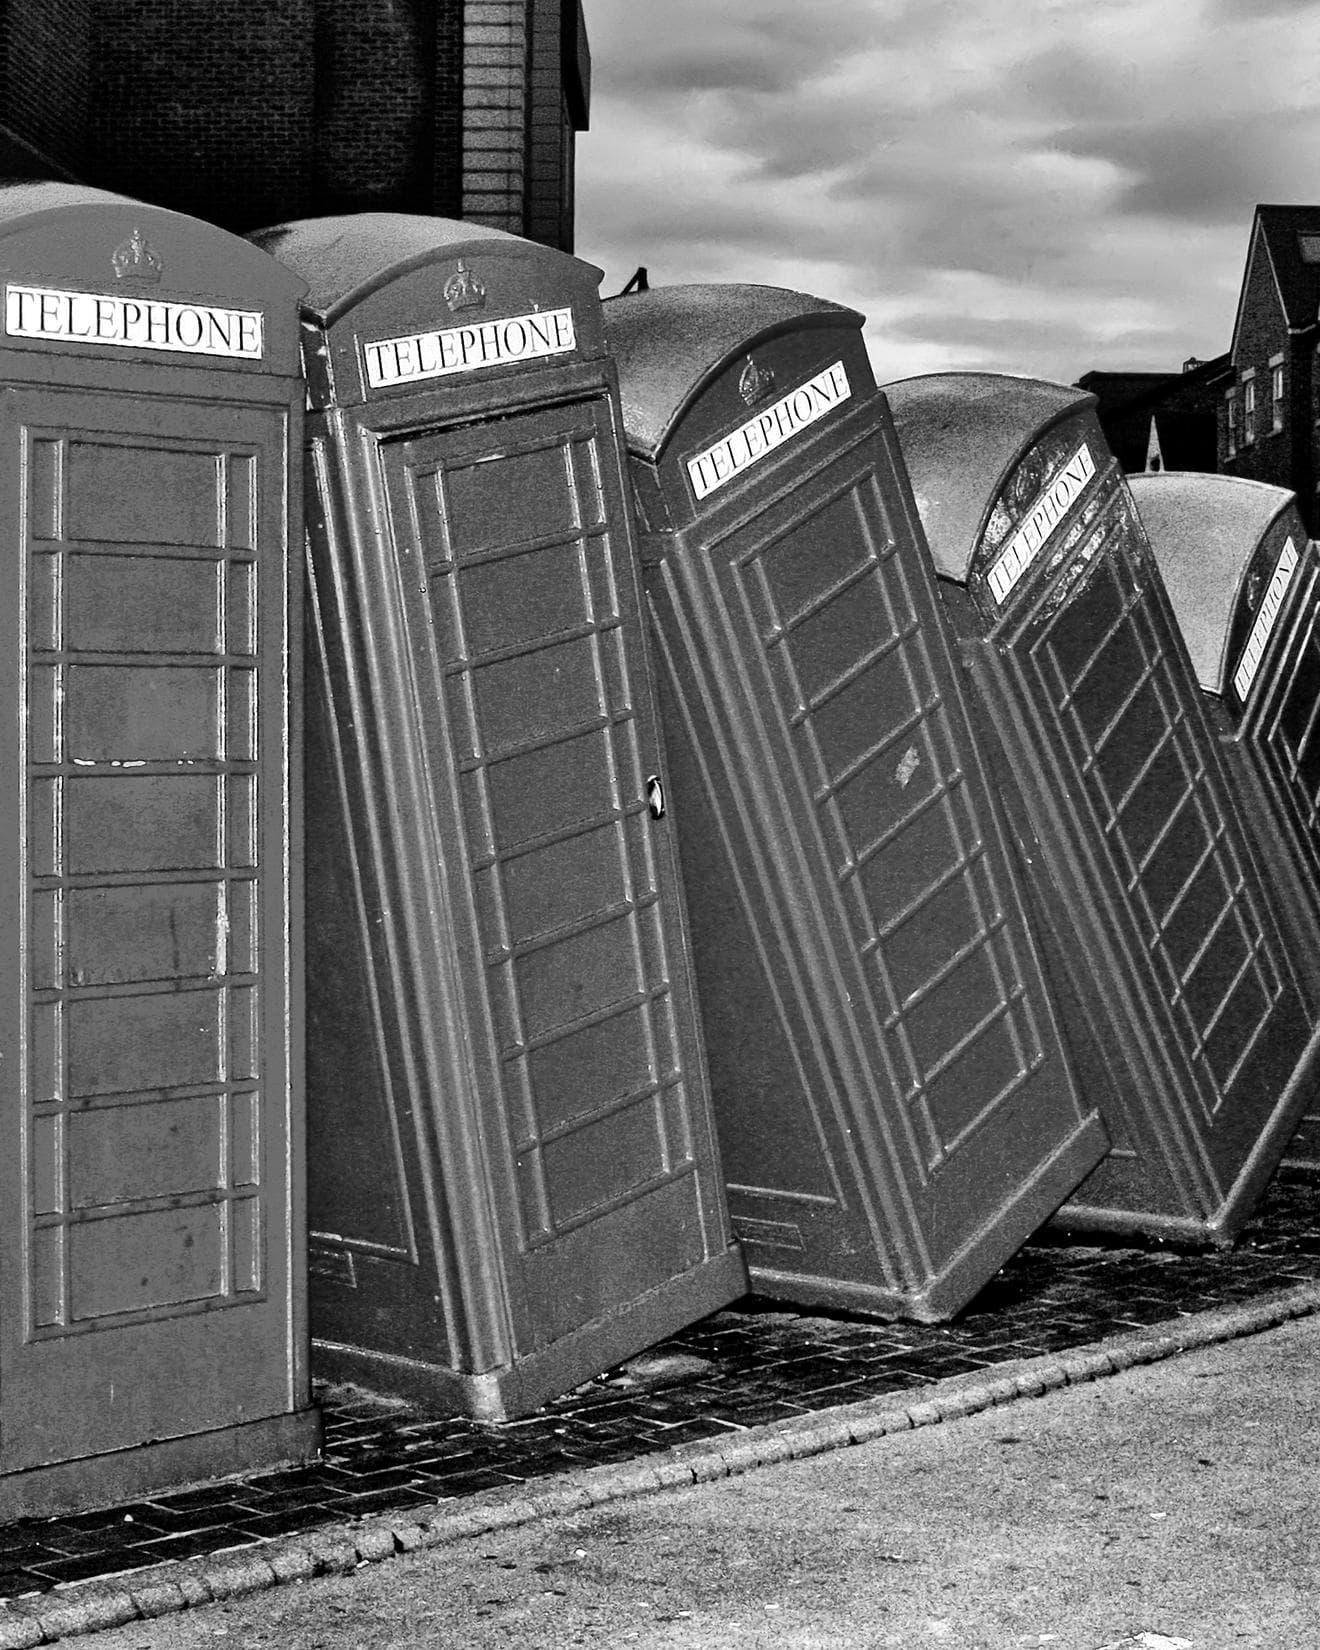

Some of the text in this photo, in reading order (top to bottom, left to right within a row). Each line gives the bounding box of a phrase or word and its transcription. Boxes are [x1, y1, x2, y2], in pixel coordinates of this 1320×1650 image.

[8, 291, 259, 352] TELEPHONE
[368, 313, 573, 381] TELEPHONE
[690, 364, 848, 492] TELEPHONE
[988, 448, 1096, 596] TELEPHONE
